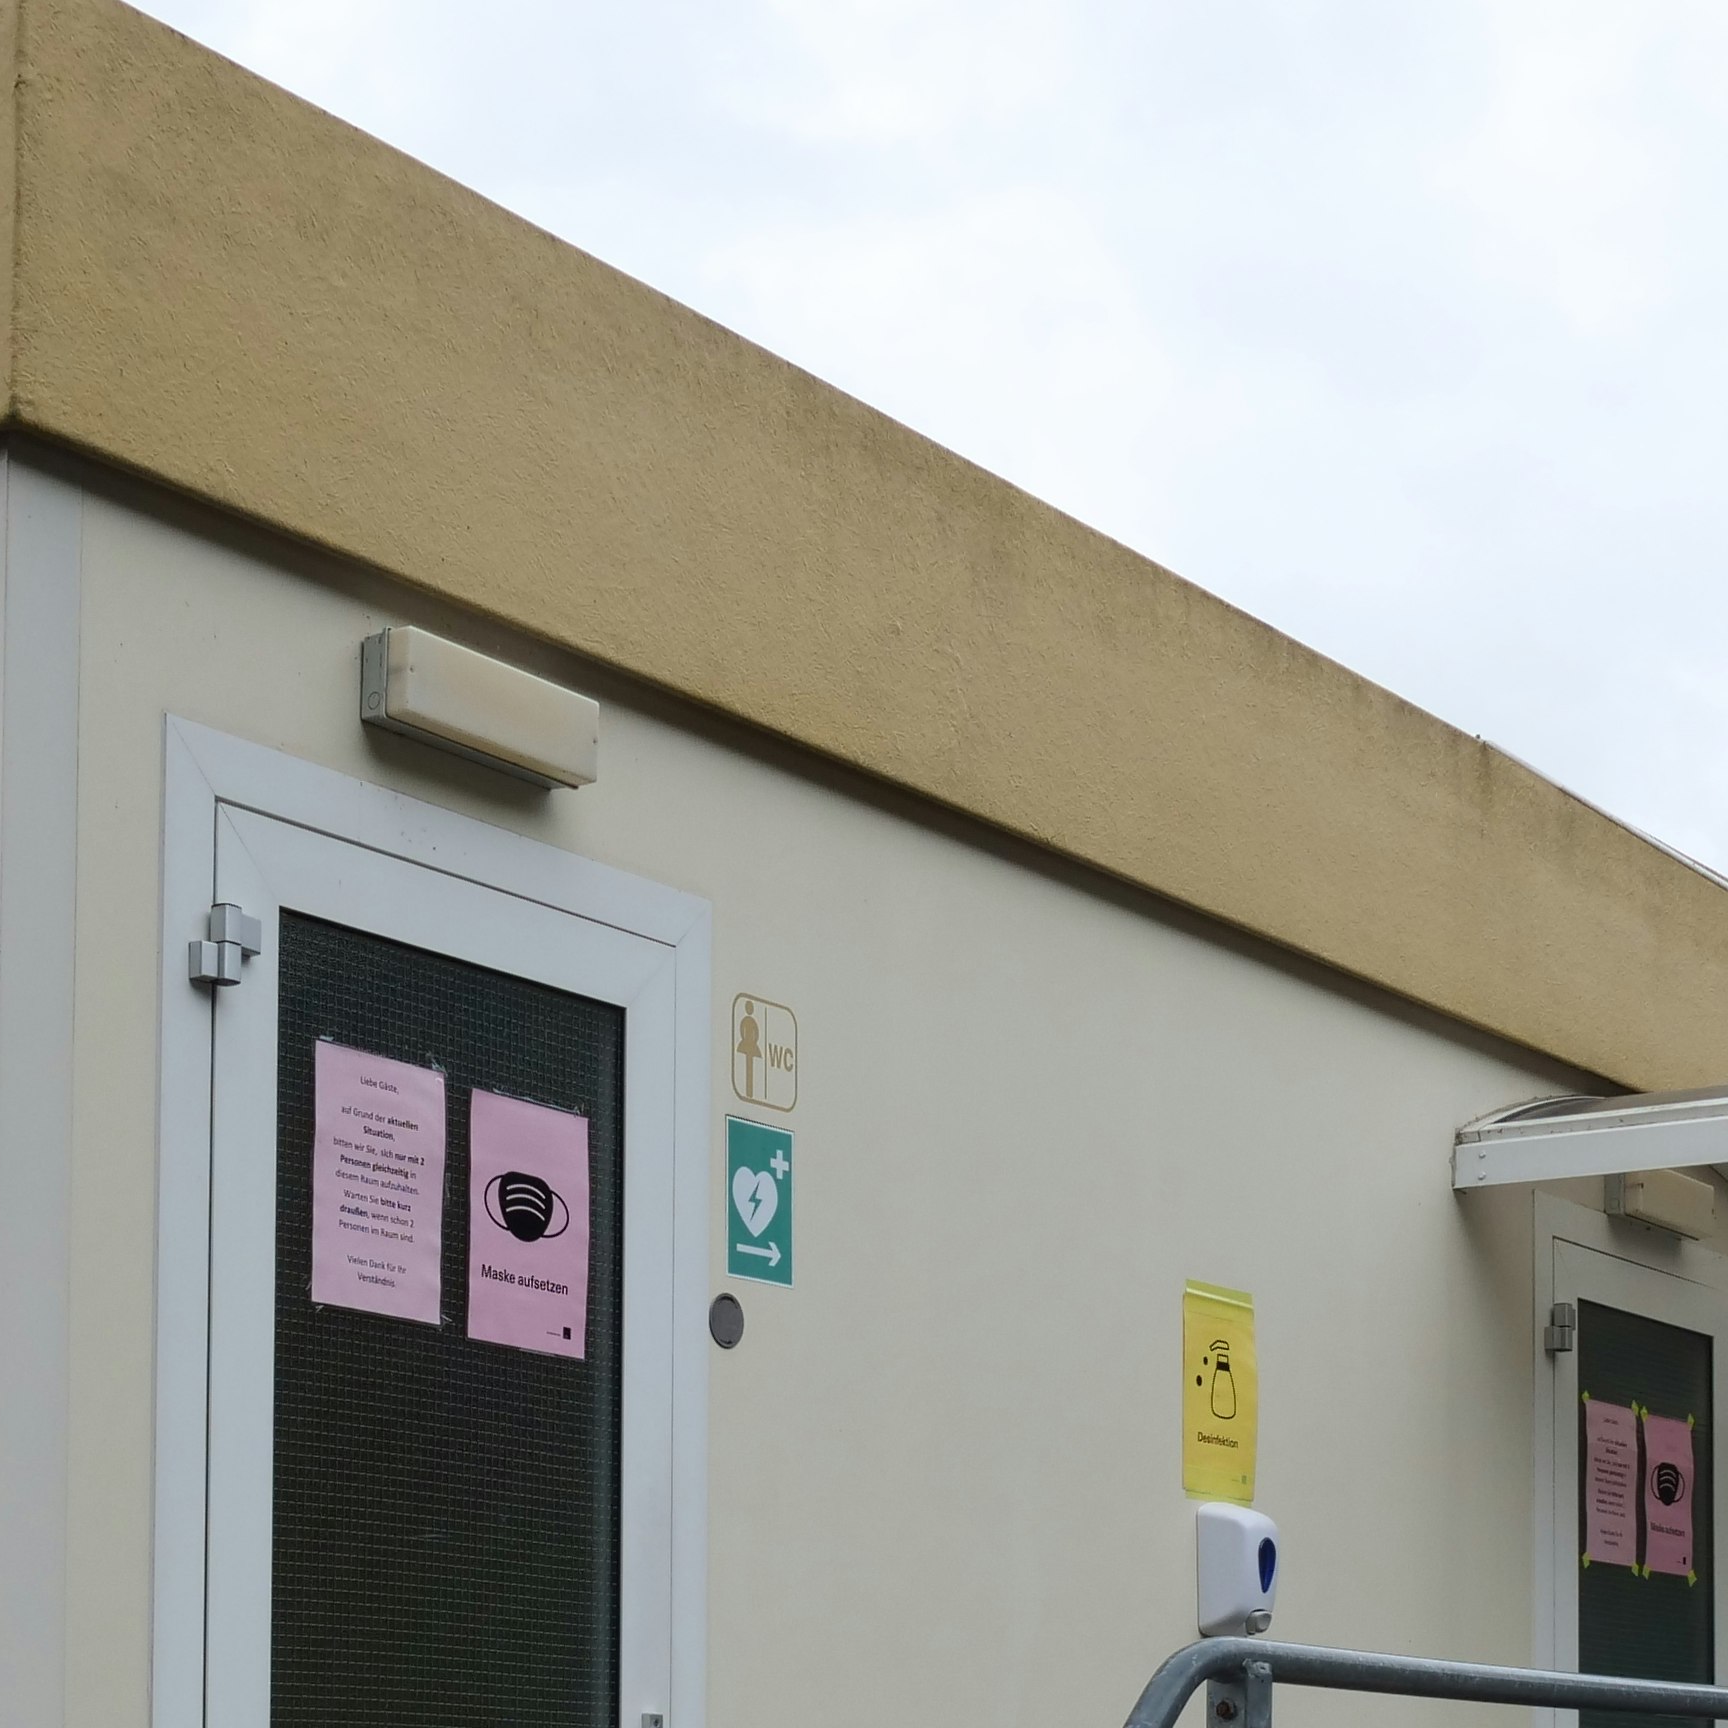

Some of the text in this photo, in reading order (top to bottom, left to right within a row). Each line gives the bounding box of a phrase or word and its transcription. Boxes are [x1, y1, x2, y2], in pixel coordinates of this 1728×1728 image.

[768, 1043, 793, 1072] WC
[360, 1076, 399, 1095] Liebe Gäste,
[341, 1106, 419, 1131] auf Grund der aktuellen
[363, 1126, 395, 1142] Situation,
[333, 1137, 353, 1148] bitten
[354, 1142, 364, 1152] wir
[366, 1145, 378, 1156] Sie,
[381, 1149, 393, 1159] sich
[395, 1152, 406, 1161] nur
[408, 1155, 419, 1164] mit
[340, 1154, 416, 1179] Personen gleichzeitig in
[335, 1169, 419, 1195] diesem Raum aufzuhalten.
[343, 1189, 411, 1212] Warten Sie bitte kurz
[339, 1204, 370, 1219] draußen,
[371, 1212, 389, 1223] wenn
[390, 1215, 409, 1227] schon
[339, 1219, 369, 1234] Personen
[371, 1225, 379, 1235] im
[380, 1228, 398, 1239] Raum
[347, 1255, 406, 1274] Vielen Dank für Ihr
[481, 1263, 568, 1295] Maske aufsetzen
[1197, 1431, 1239, 1448] Desinfektion
